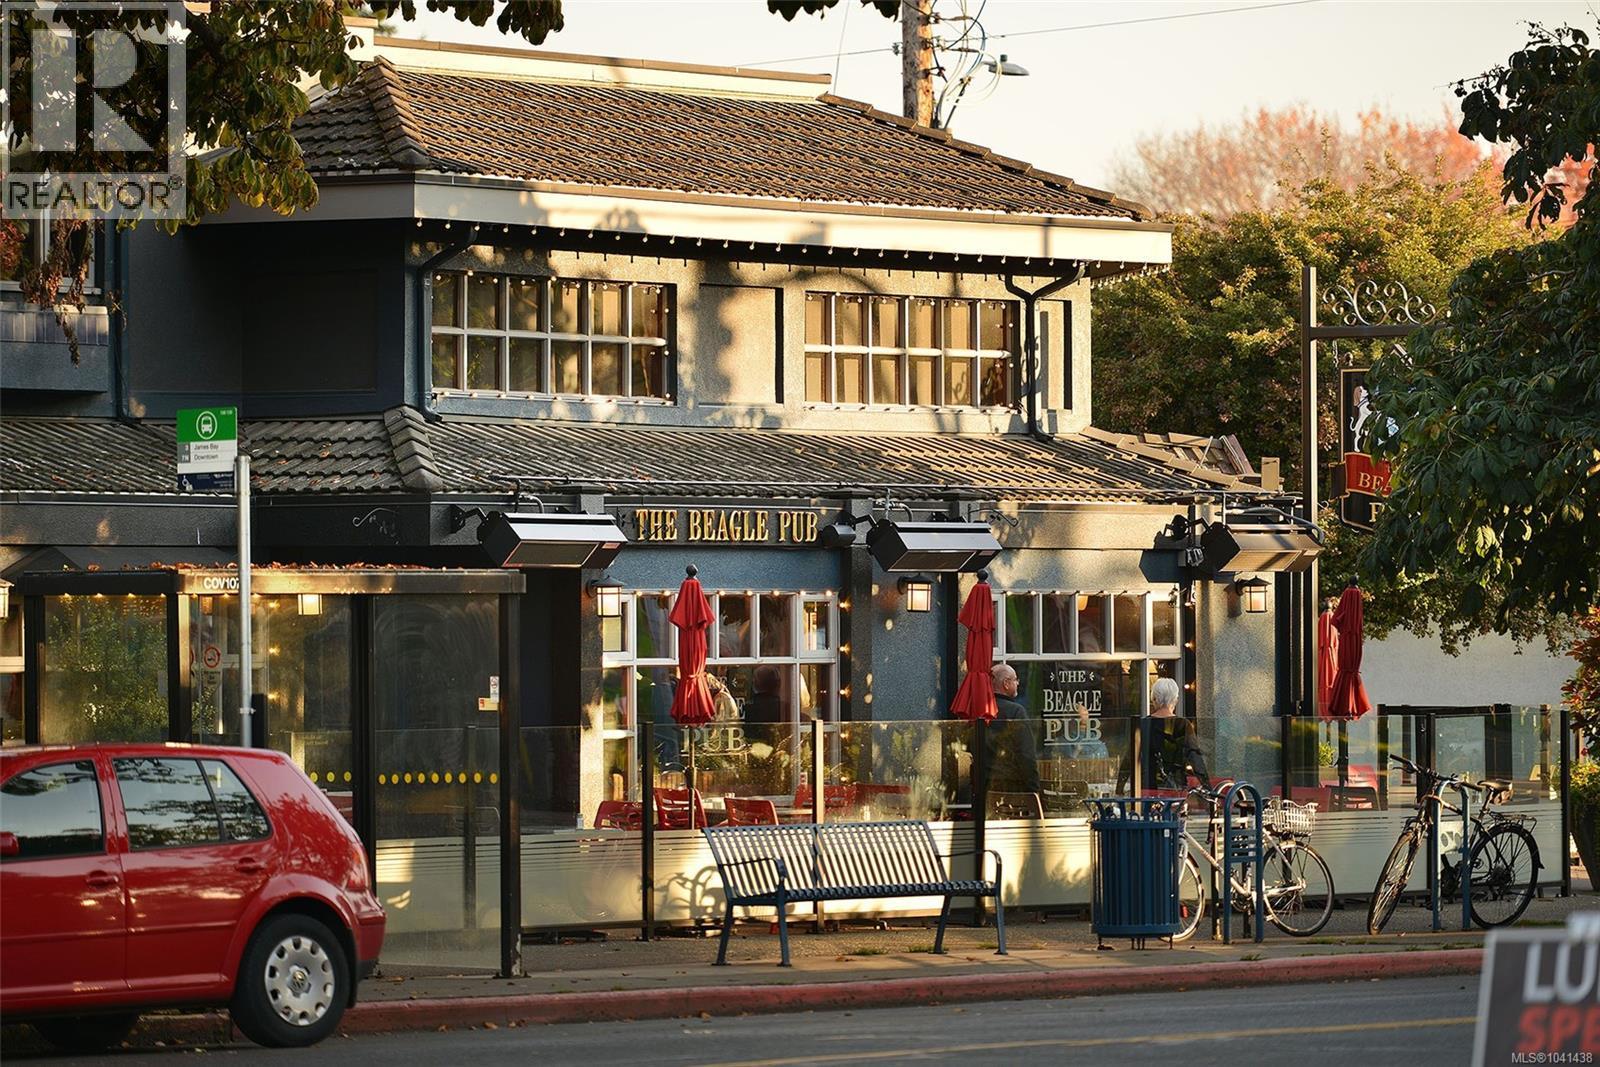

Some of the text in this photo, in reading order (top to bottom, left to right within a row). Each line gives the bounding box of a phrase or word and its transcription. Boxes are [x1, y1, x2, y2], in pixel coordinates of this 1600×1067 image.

[635, 508, 818, 543] THE BEAGLE PUB
[1058, 670, 1086, 683] THE
[1042, 688, 1102, 712] BEAGLE
[680, 727, 745, 753] PUB
[1043, 718, 1102, 742] PUB
[1523, 941, 1600, 1003] LU
